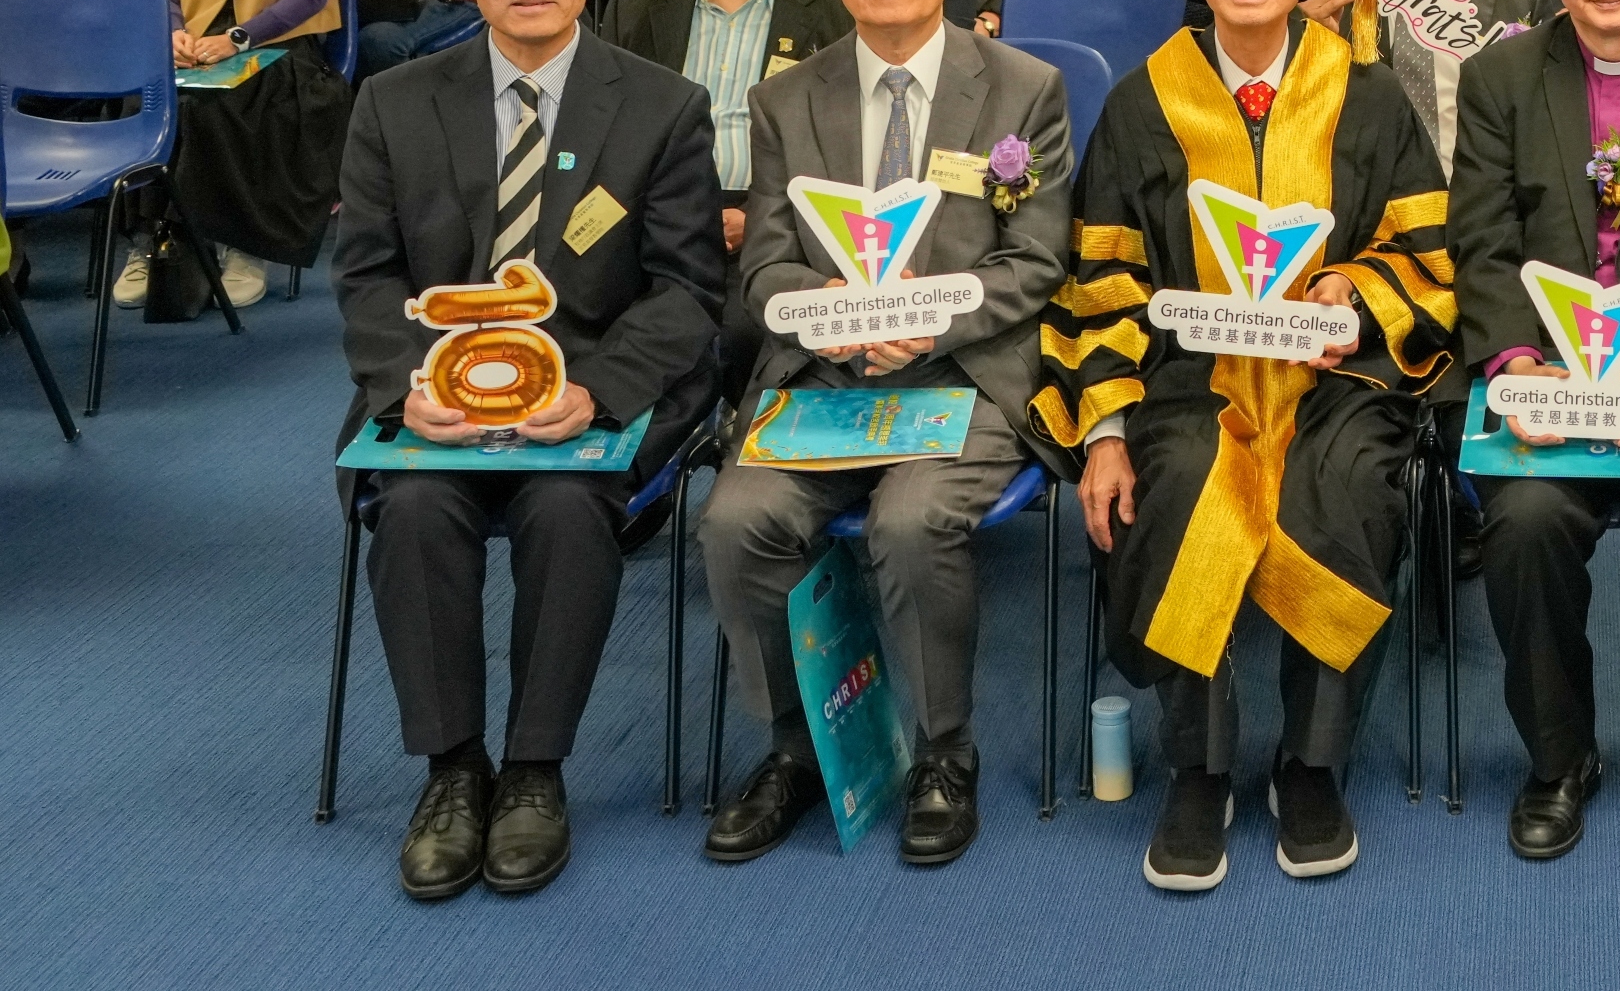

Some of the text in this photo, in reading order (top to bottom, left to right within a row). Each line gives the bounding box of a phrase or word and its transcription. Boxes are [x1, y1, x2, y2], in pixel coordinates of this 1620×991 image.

[778, 287, 972, 321] Gratia Christian College
[811, 309, 938, 337] 宏恩基督教學院
[1160, 303, 1348, 336] Gratia Christian College
[1189, 325, 1312, 350] 宏恩基督教學院
[1500, 388, 1548, 404] Gratia
[823, 655, 877, 721] CHRIST
